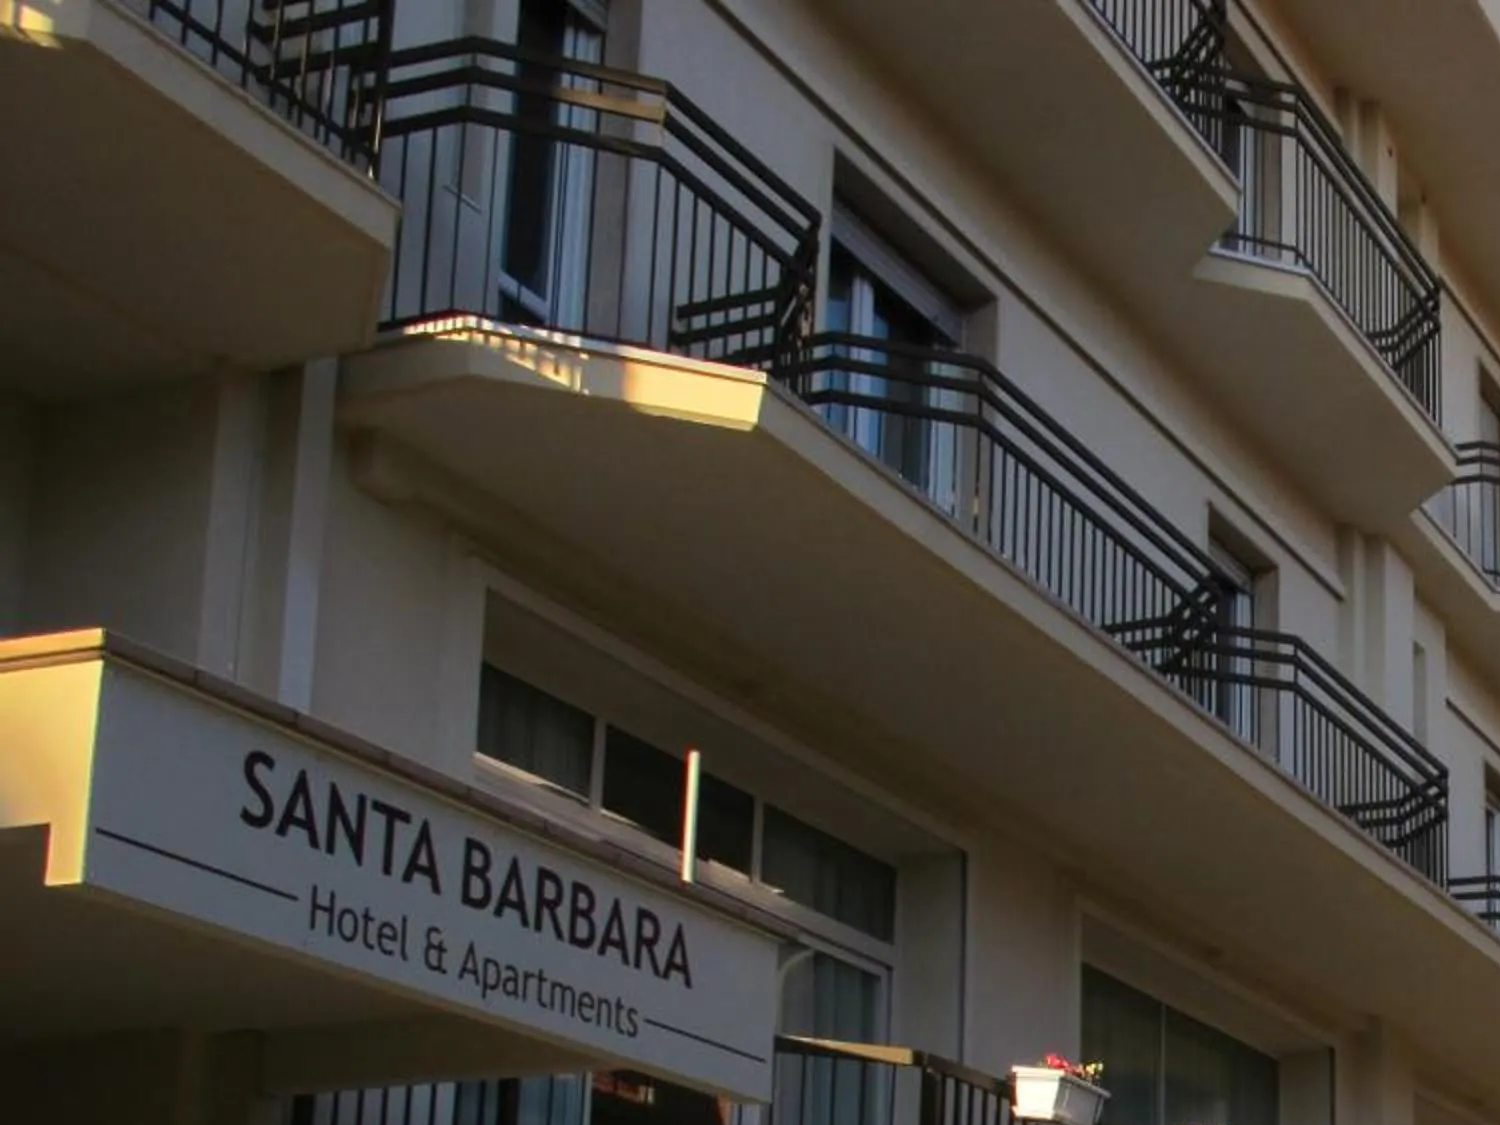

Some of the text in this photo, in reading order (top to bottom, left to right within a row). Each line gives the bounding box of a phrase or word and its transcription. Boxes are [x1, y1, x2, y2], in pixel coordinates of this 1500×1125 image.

[240, 751, 692, 988] SANTA BARBARA
[309, 885, 640, 1038] Hotel & Apartments
